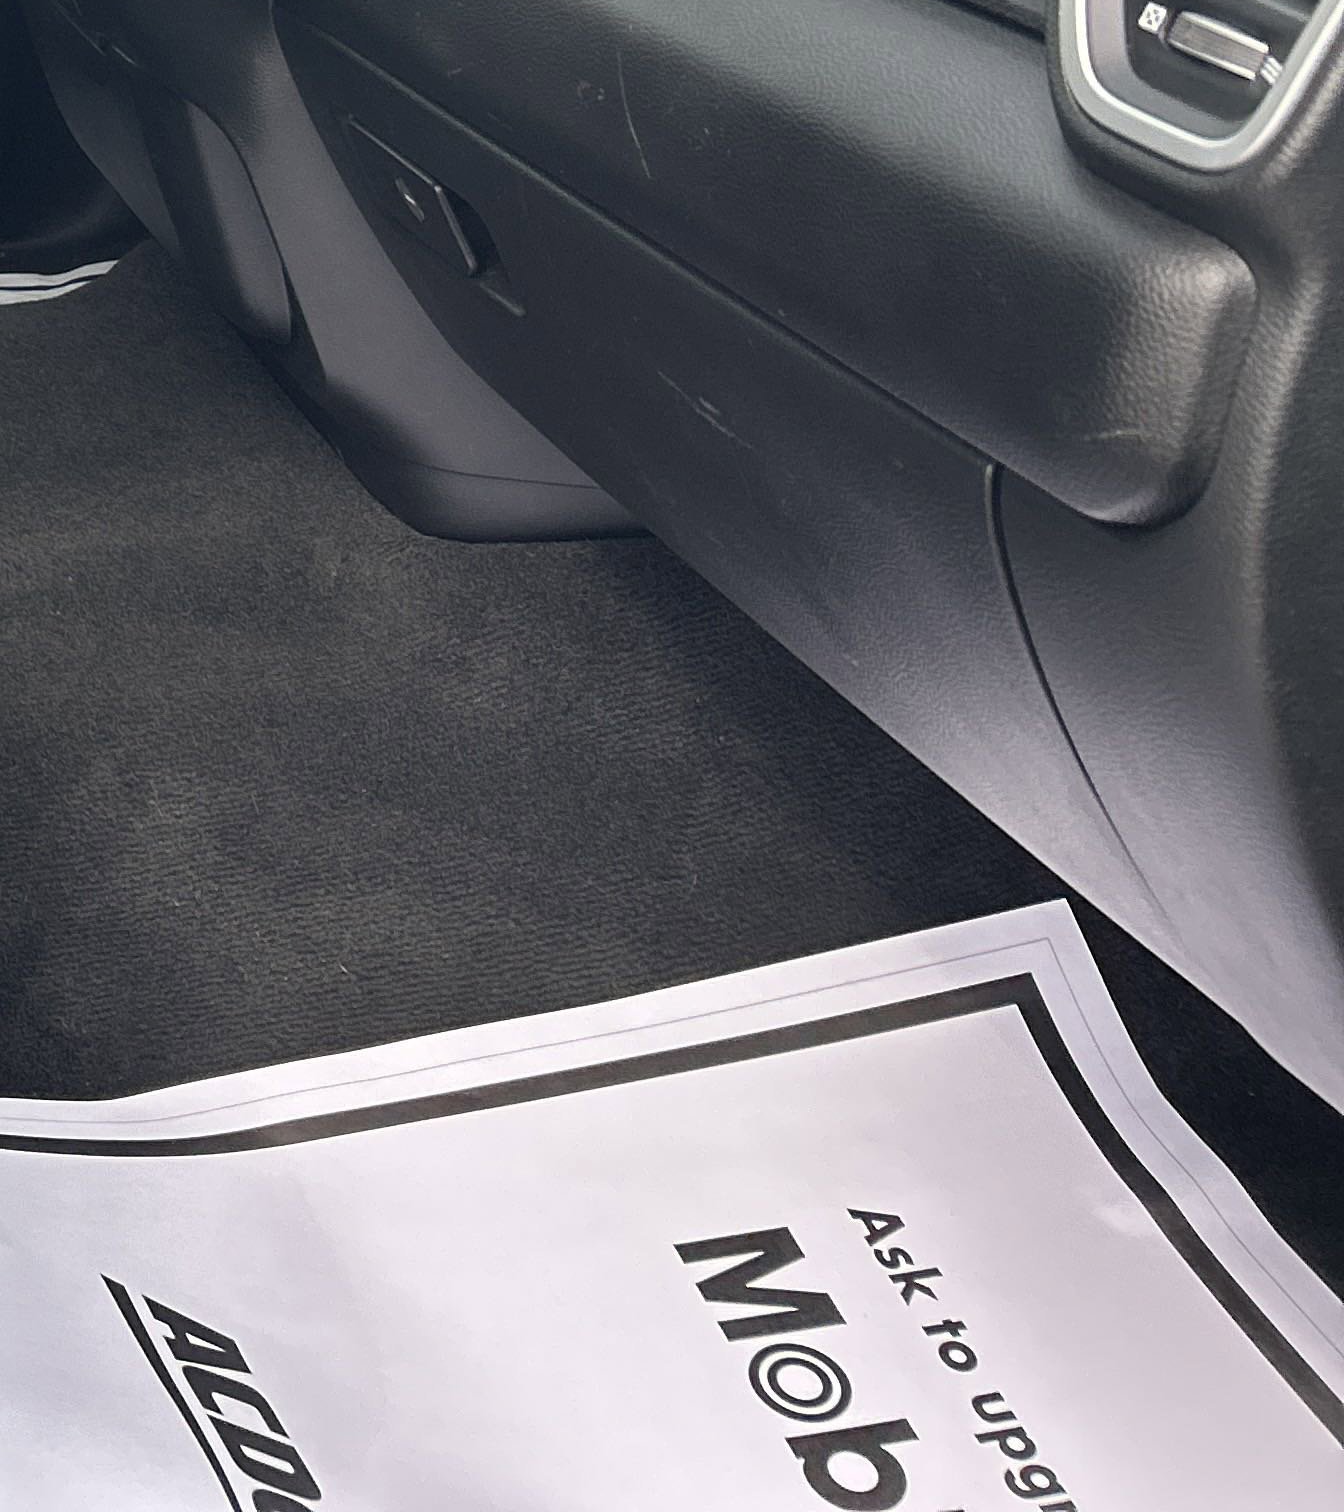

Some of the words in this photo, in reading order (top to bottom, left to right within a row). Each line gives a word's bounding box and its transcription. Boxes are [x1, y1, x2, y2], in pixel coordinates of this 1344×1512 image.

[672, 1226, 964, 1512] Mob
[846, 1207, 944, 1306] Ask
[921, 1318, 978, 1373] to
